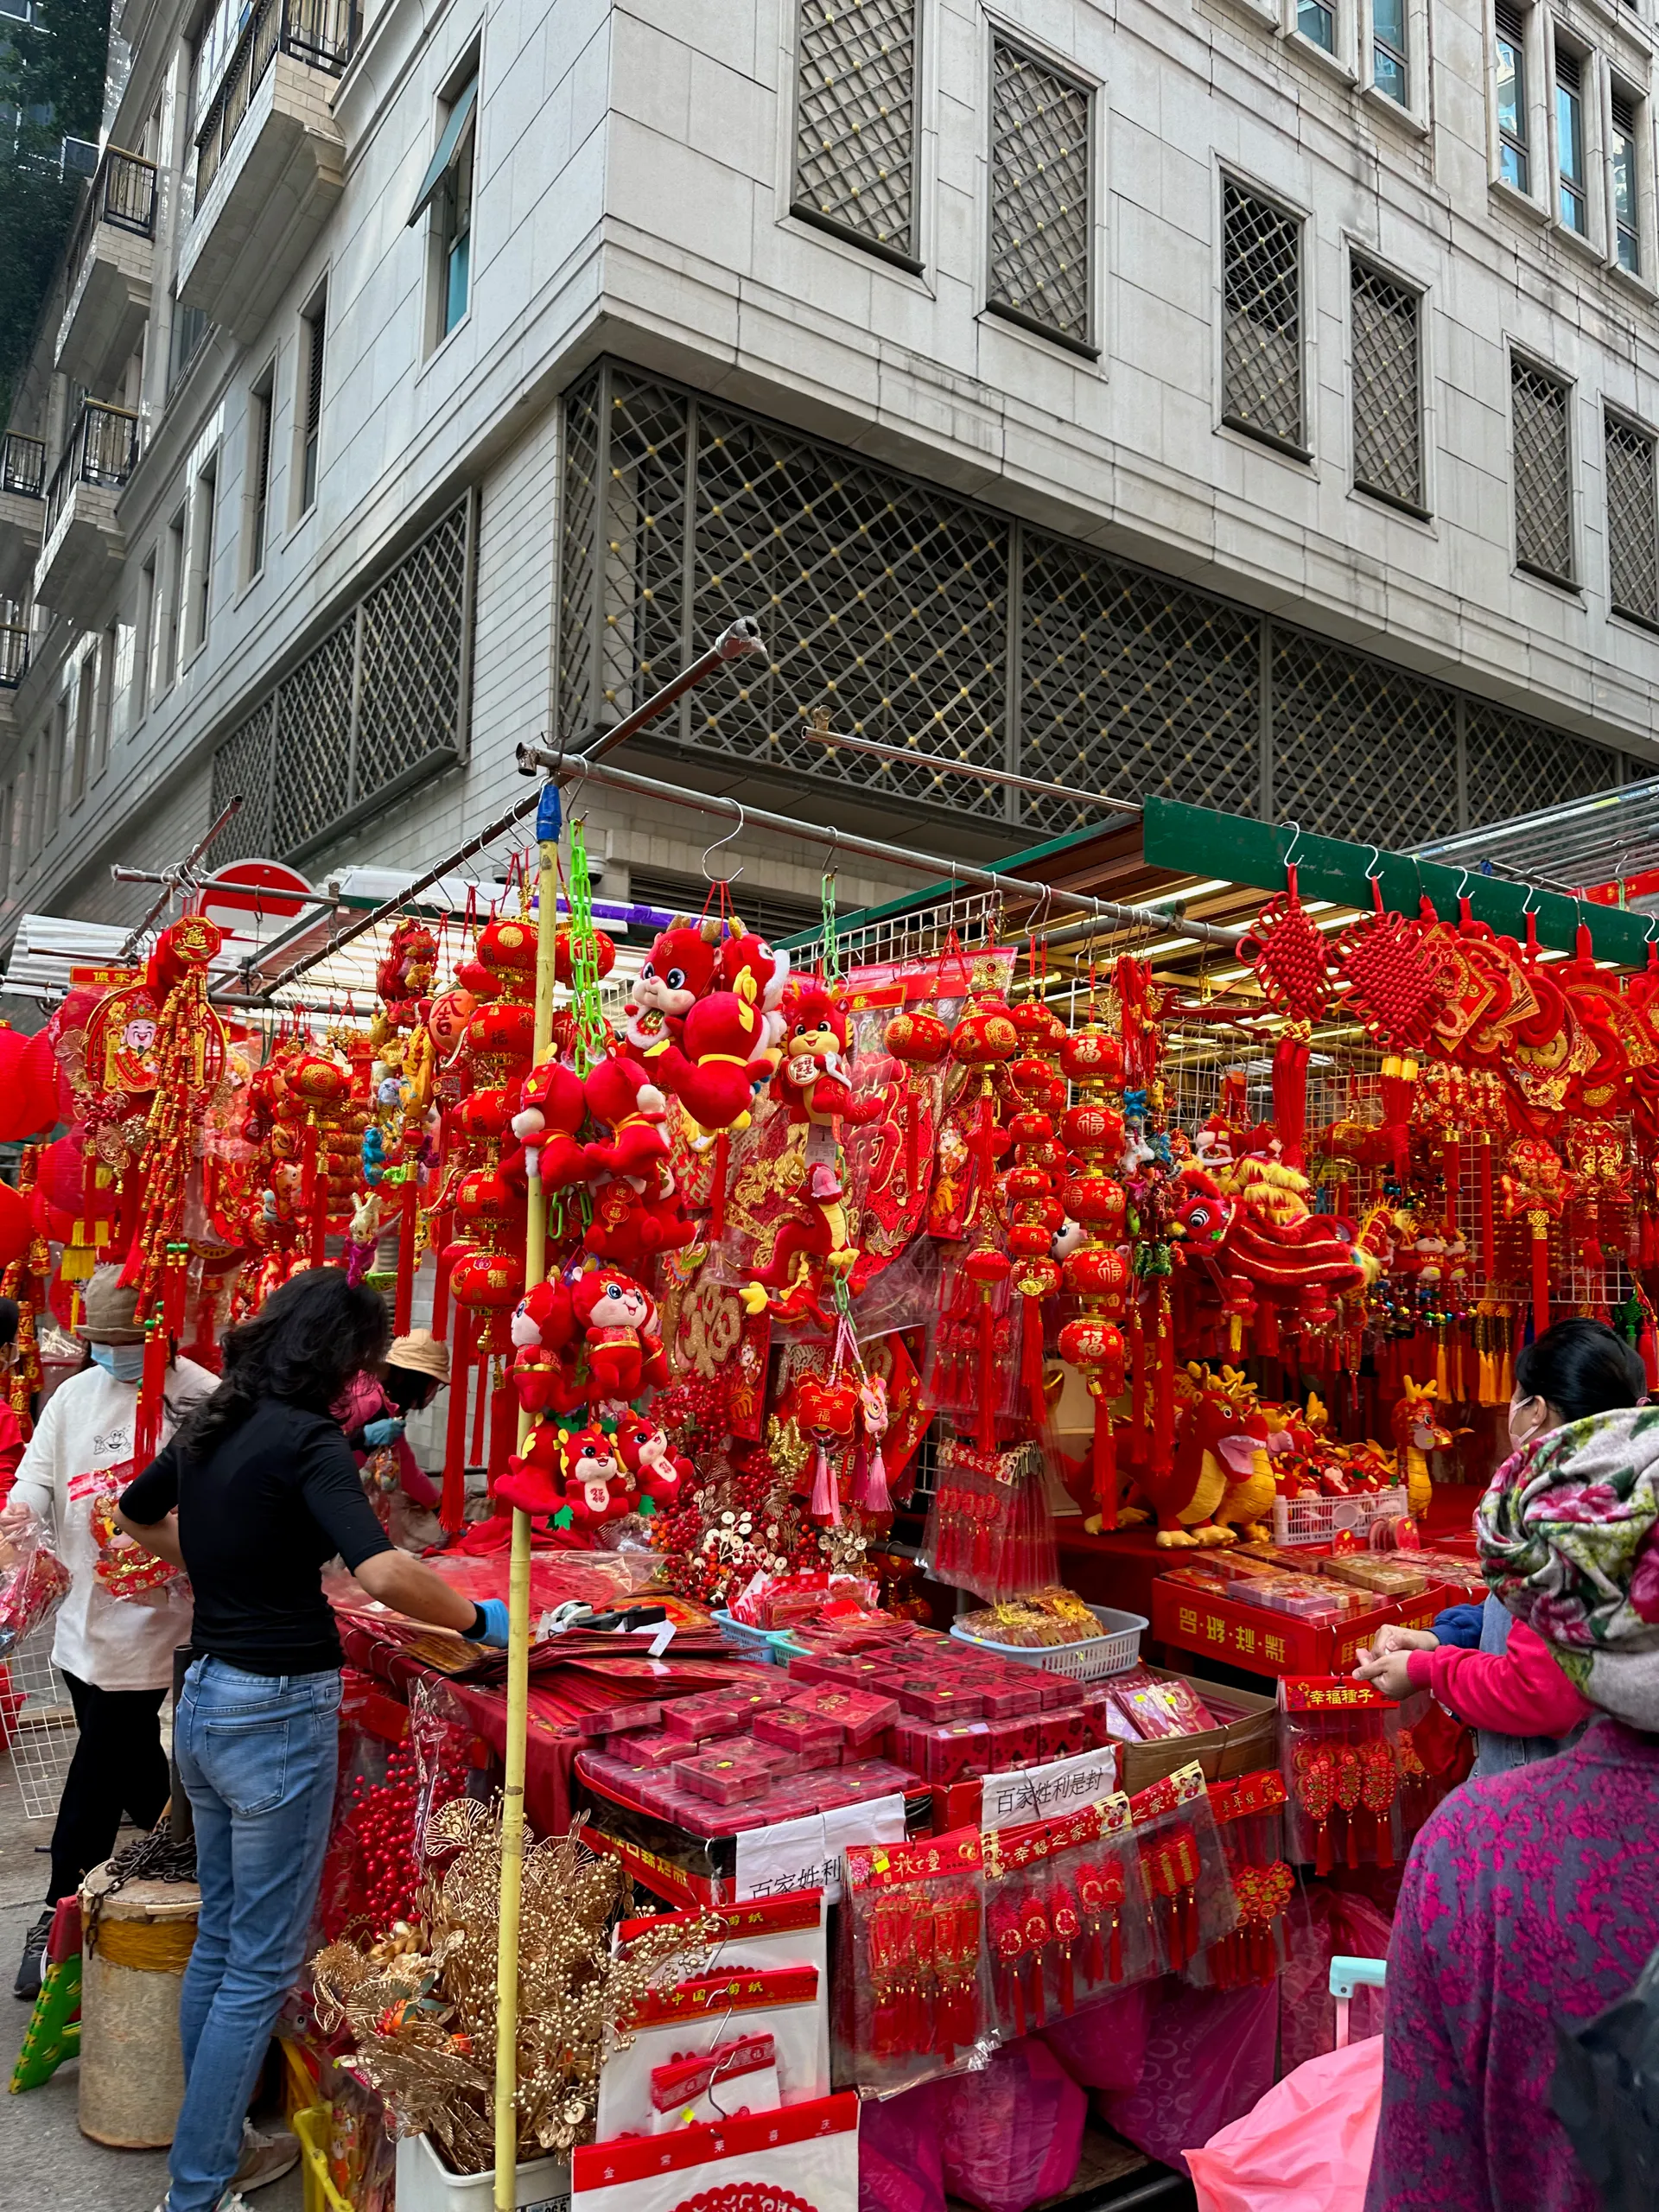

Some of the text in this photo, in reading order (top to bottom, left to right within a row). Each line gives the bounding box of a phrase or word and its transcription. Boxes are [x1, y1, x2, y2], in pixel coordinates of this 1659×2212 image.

[432, 992, 464, 1036] 大吉
[1073, 1039, 1103, 1064] 福
[1077, 1112, 1105, 1136] 福
[462, 1185, 478, 1203] 福
[1062, 1185, 1084, 1208] 福
[1105, 1186, 1124, 1213] 福
[487, 1269, 508, 1289] 福
[1096, 1258, 1123, 1283] 福
[1077, 1330, 1106, 1357] 福
[809, 1395, 844, 1409] 平安
[816, 1408, 831, 1423] 福
[1309, 1688, 1374, 1706] 幸福種子
[996, 1767, 1104, 1815] 百家姓利是封
[1132, 1795, 1166, 1821] 之家
[1014, 1821, 1087, 1864] 幸福之家
[749, 1855, 842, 1899] 百家姓利
[671, 1981, 763, 2006] 中国剪纸
